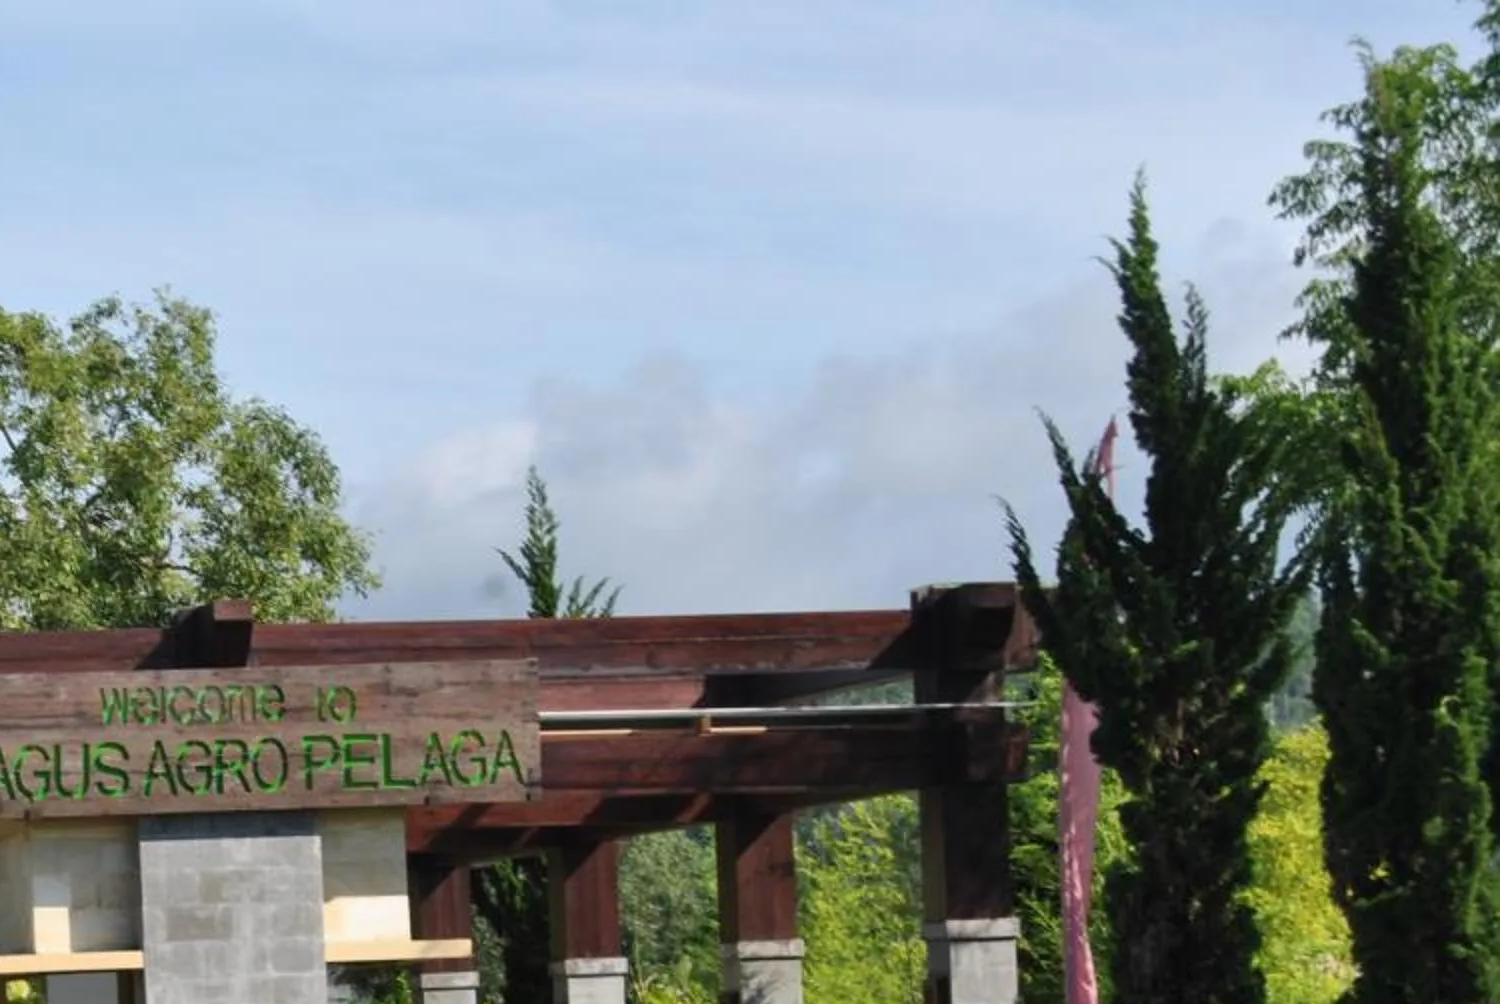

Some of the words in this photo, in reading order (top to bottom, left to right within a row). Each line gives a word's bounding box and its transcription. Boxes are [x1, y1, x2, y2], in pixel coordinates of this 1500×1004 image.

[316, 685, 357, 723] to
[144, 736, 288, 796] AGRO
[303, 729, 525, 790] PELAGA
